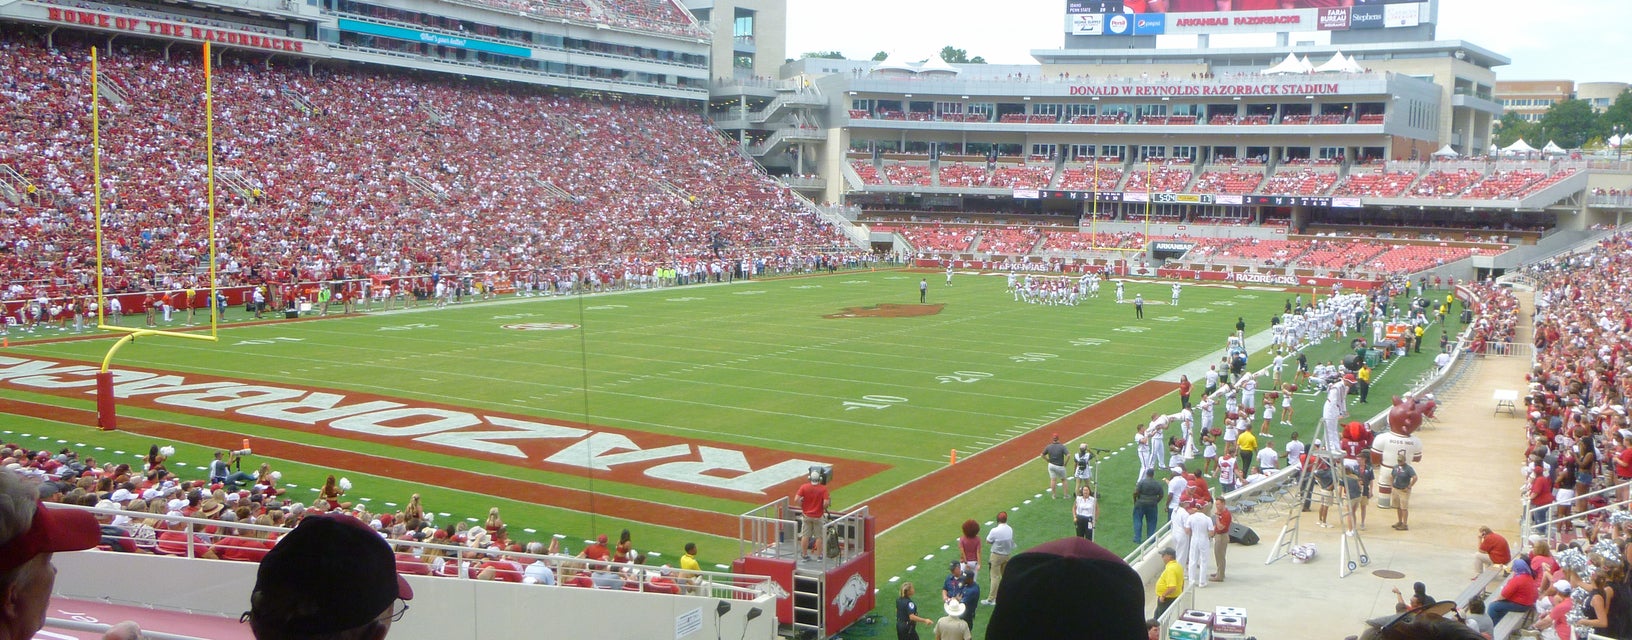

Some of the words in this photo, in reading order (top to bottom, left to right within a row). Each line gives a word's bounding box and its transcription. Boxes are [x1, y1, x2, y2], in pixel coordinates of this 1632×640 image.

[1176, 18, 1228, 26] ARKANSAS
[1234, 16, 1300, 25] RAZORBACKS
[1352, 13, 1382, 22] Stephens
[48, 7, 110, 28] HOME
[115, 16, 140, 30] OF
[146, 20, 184, 37] THE
[190, 26, 304, 52] RAZORBACKS
[1069, 86, 1119, 95] DONALD
[1122, 86, 1132, 95] W
[1135, 86, 1199, 95] REYNOLDS
[1202, 85, 1278, 95] RAZORBACK
[1282, 84, 1338, 94] STADIUM
[935, 370, 994, 384] 20
[842, 394, 909, 410] 10
